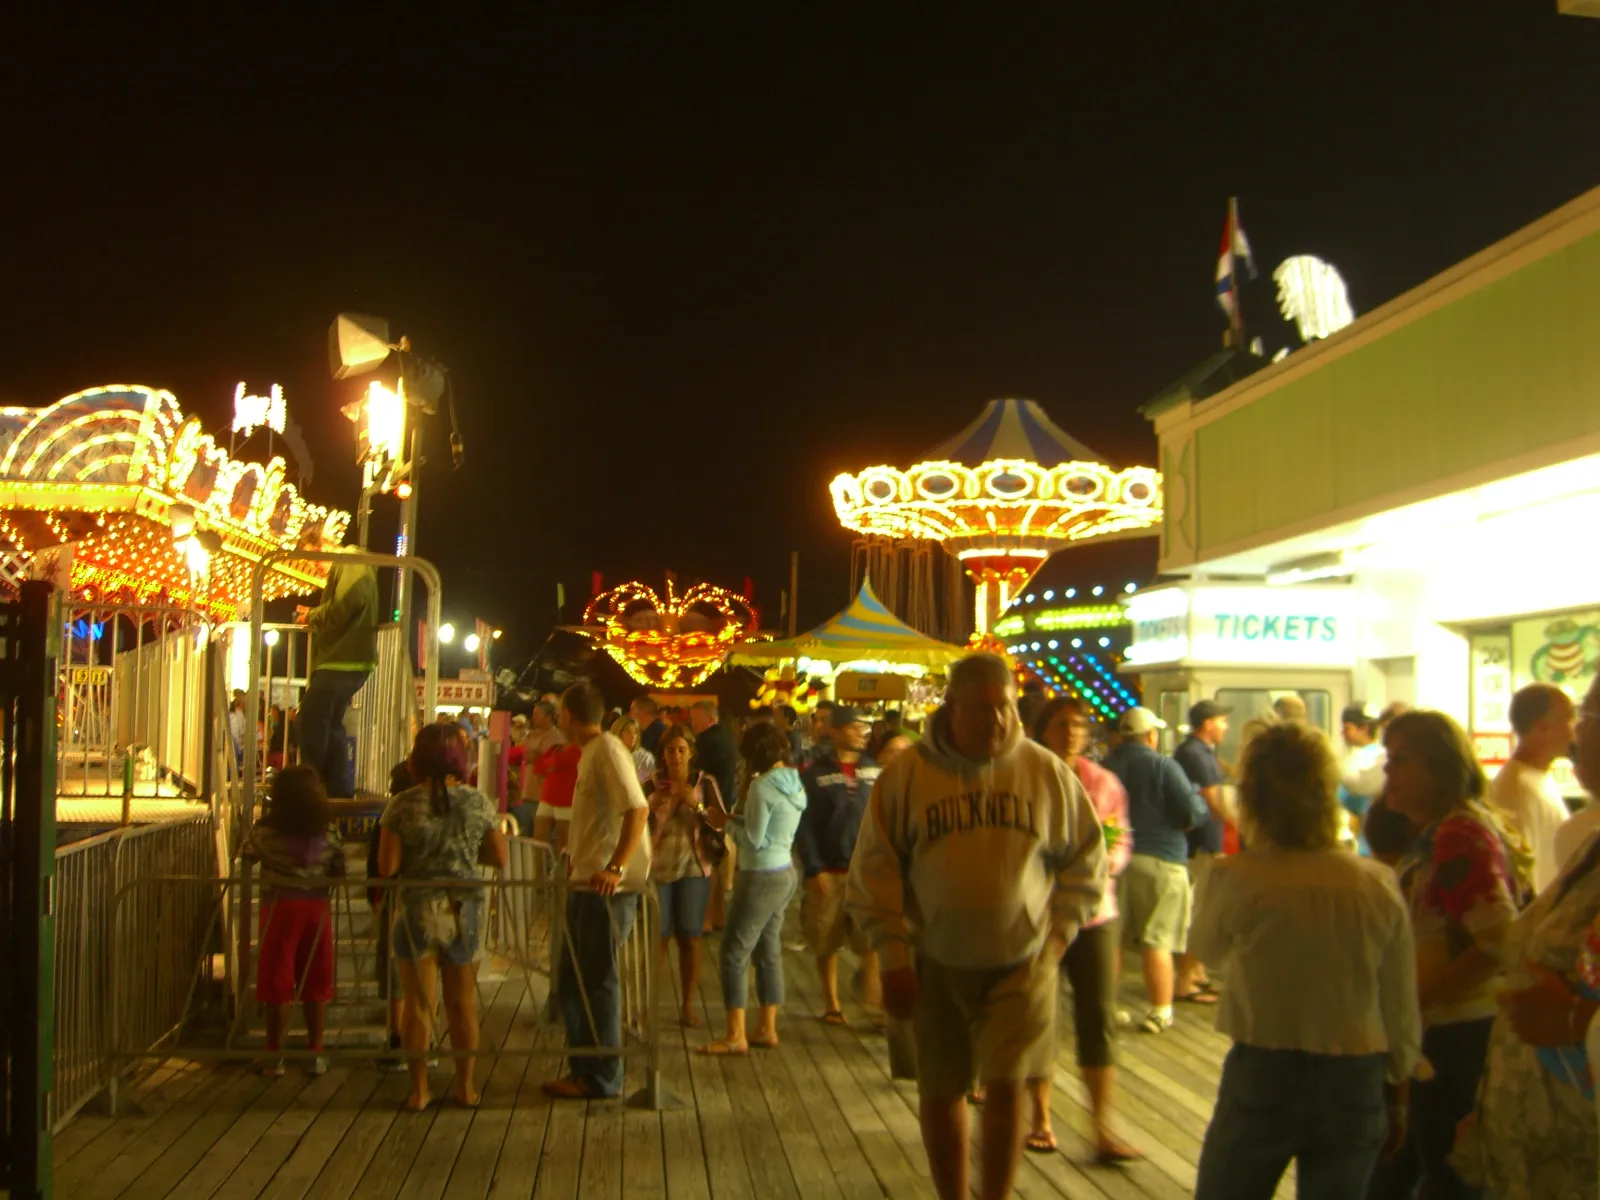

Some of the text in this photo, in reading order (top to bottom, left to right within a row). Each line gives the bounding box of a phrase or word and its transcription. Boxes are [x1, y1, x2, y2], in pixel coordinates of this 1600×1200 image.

[1214, 614, 1337, 641] TICKETS
[76, 670, 103, 683] EXIT
[416, 685, 483, 699] TKETS
[925, 789, 1040, 842] BUCKNELL
